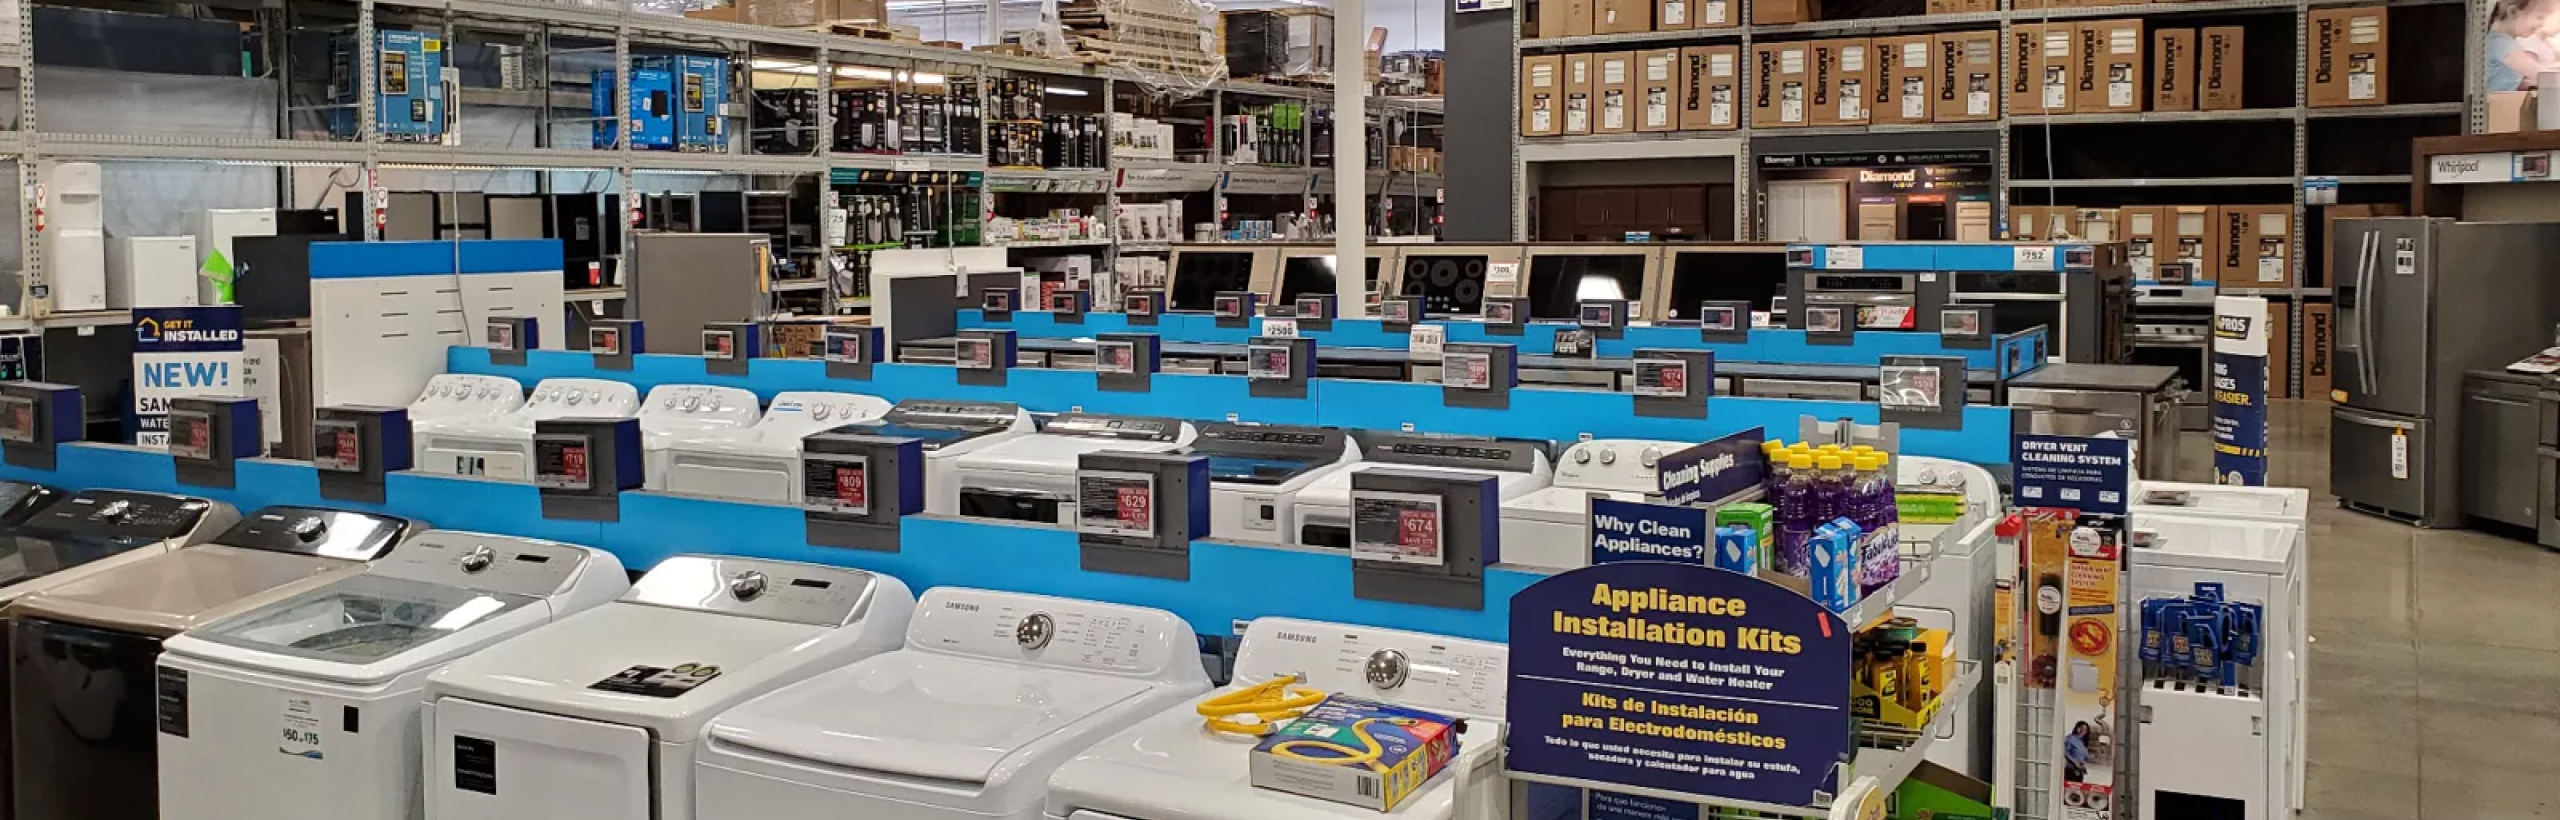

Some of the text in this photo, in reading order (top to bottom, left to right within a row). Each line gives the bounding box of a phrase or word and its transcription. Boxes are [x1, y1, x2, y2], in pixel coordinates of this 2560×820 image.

[2016, 32, 2028, 93] Diamond
[2080, 29, 2095, 91] Diamond
[2162, 37, 2175, 91] Diamond
[2209, 34, 2222, 89] Diamond
[2316, 19, 2331, 83] Diamond
[1688, 55, 1700, 110] Diamond
[1758, 51, 1770, 107] Diamond
[1815, 47, 1827, 105] Diamond
[1877, 45, 1890, 103] Diamond
[1942, 41, 1954, 100] Diamond
[1860, 169, 1916, 183] Diamond
[2437, 160, 2479, 175] Whirlpool
[2227, 212, 2240, 268] Diamond
[164, 320, 193, 329] GET IT
[164, 330, 238, 342] INSTALLED
[2311, 313, 2326, 376] Diamond
[143, 362, 228, 388] NEW!
[2022, 441, 2089, 452] DRYER VENT
[2022, 453, 2121, 466] CLEANING SYSTEM
[1663, 453, 1735, 490] Cleaning Supplies
[1121, 495, 1147, 508] $629
[1404, 518, 1433, 532] $674
[1594, 514, 1691, 538] Why Clean
[1594, 534, 1703, 559] Appliances?
[945, 600, 980, 612] SAMSUNG
[1591, 583, 1747, 617] Appliance
[1276, 631, 1318, 643] SAMSUNG
[1553, 611, 1803, 655] Installation Kits
[1562, 647, 1785, 678] Everything You Need to Install Your
[1576, 662, 1774, 690] Range, Dryer and Water Heater
[1581, 692, 1759, 725] Kits de Instalación
[1562, 714, 1787, 750] para Electrodomésticos
[1544, 735, 1801, 775] Todo lo que usted necesita para instalar su estufa,
[1588, 753, 1755, 780] secadora y calentador para agua
[1594, 792, 1612, 802] Para
